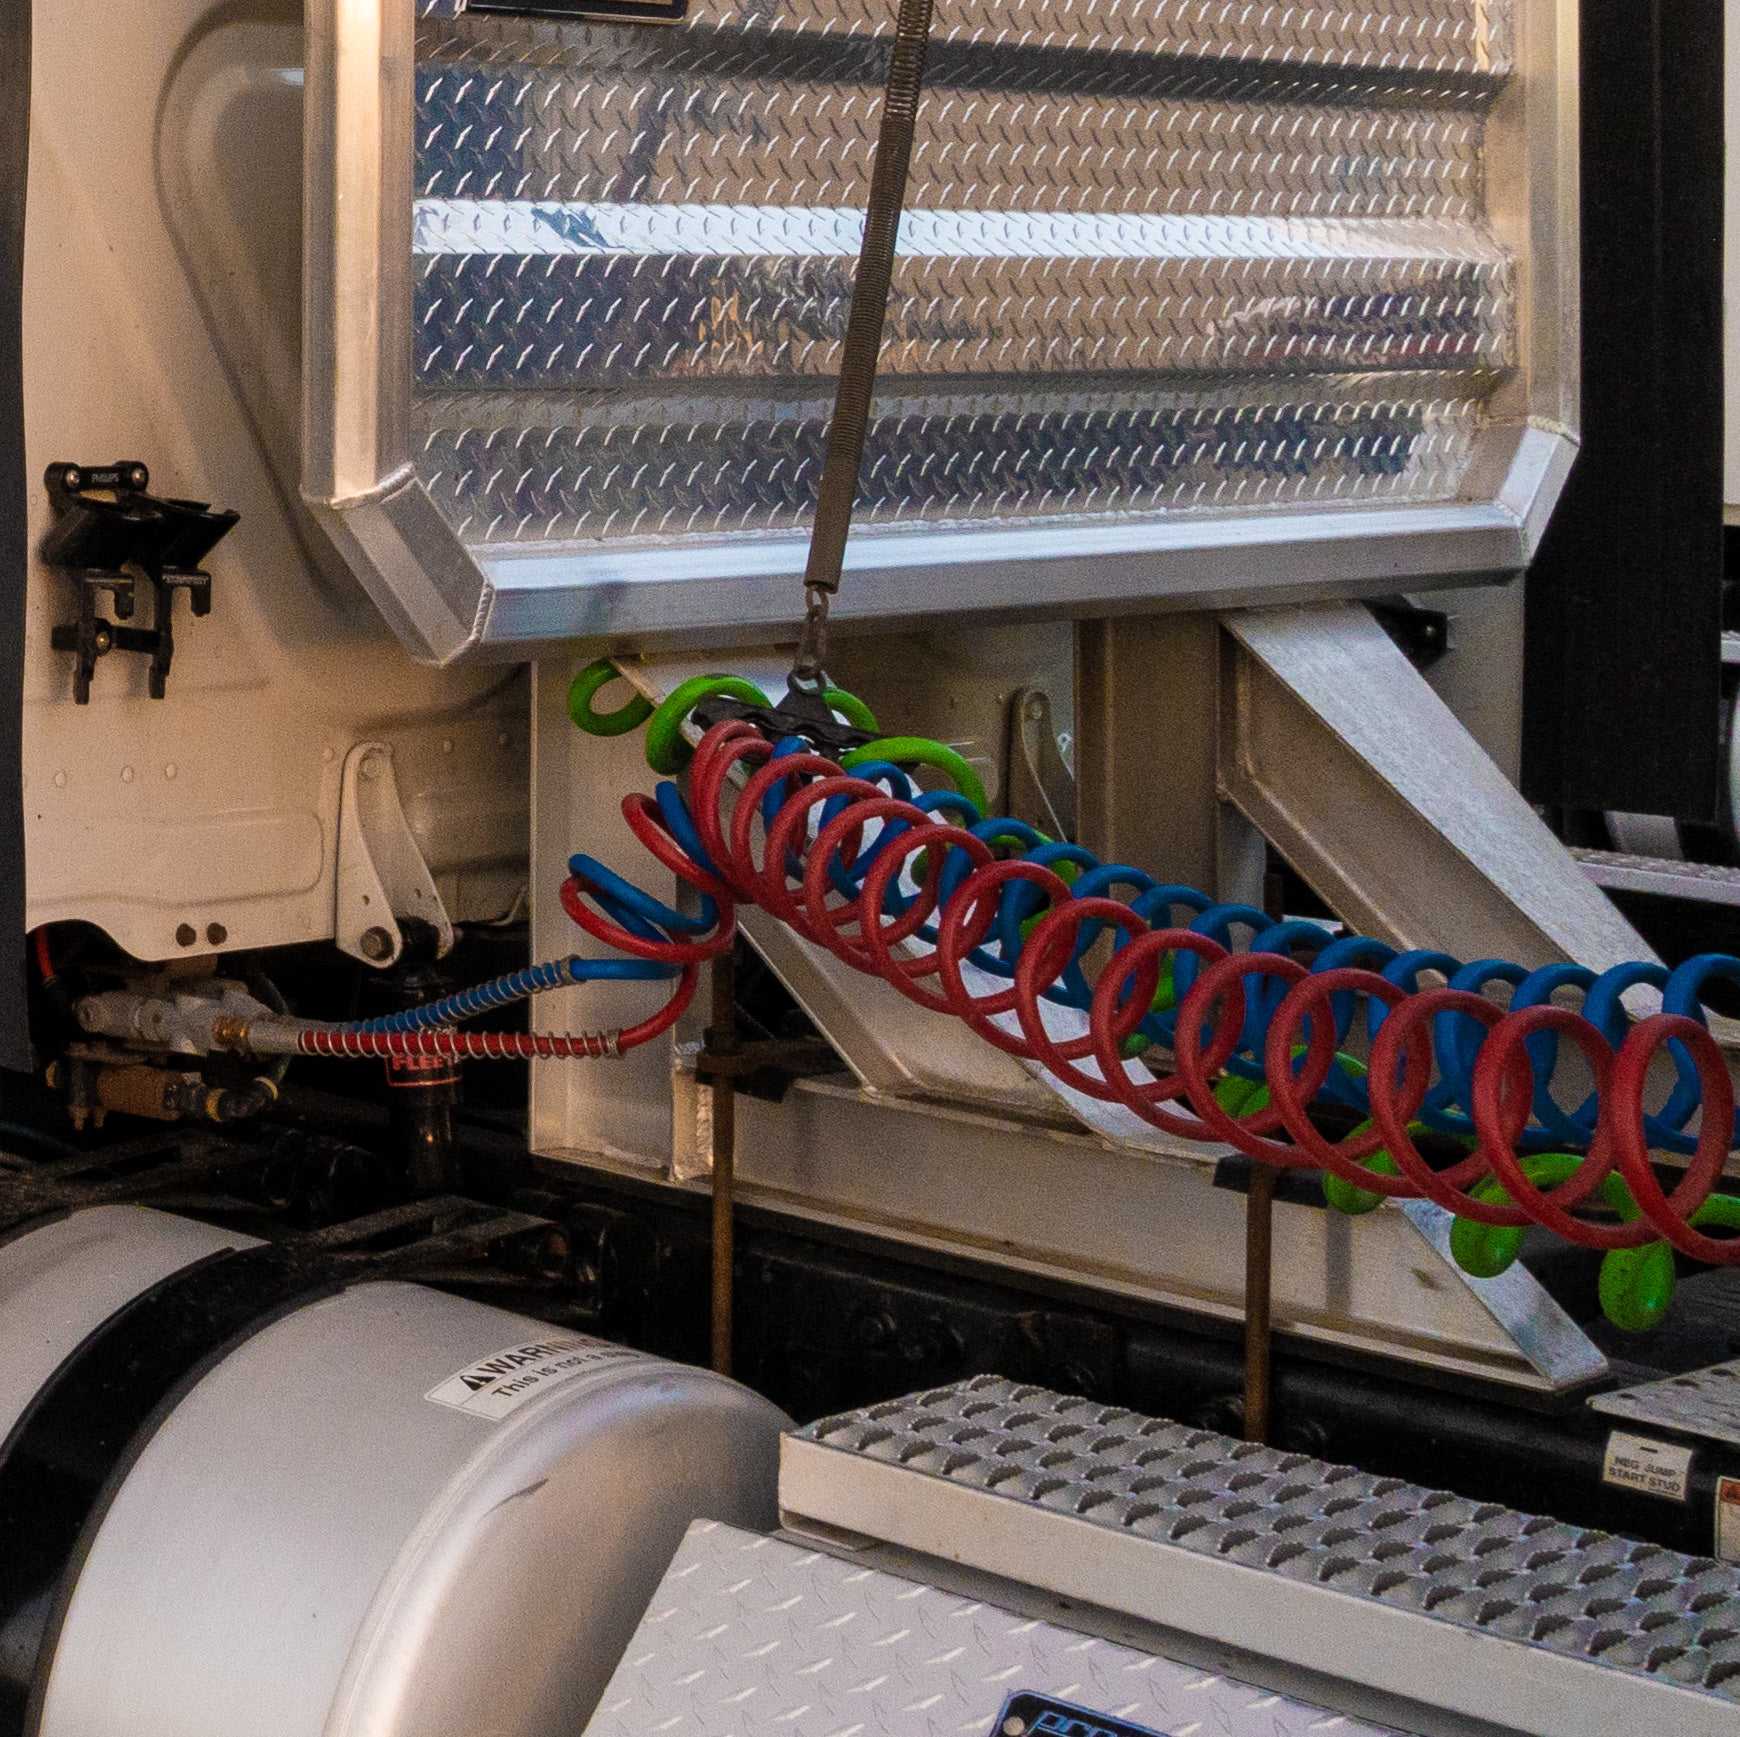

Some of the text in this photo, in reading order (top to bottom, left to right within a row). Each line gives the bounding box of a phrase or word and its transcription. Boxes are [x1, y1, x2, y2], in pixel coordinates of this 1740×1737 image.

[491, 1374, 539, 1398] This
[539, 1365, 557, 1378] is
[1614, 1456, 1639, 1470] NEG
[1609, 1467, 1680, 1493] START STUD
